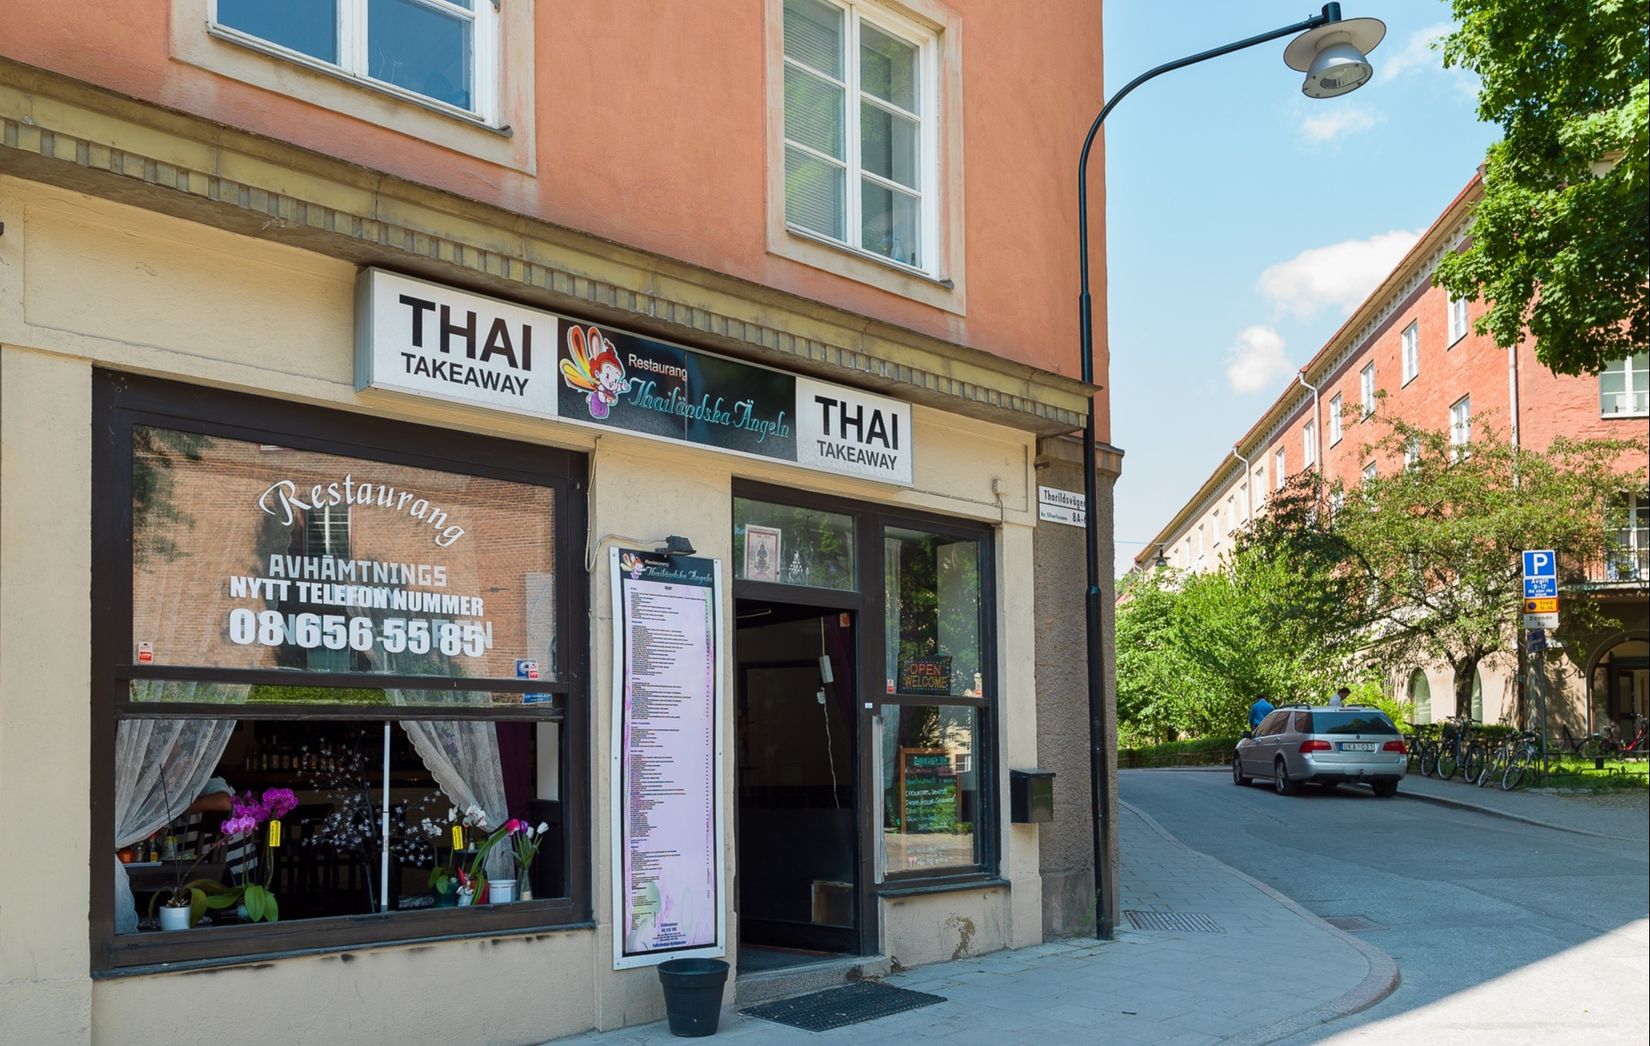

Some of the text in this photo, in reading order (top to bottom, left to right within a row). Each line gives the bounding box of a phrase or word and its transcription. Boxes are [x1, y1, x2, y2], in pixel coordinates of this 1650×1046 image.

[399, 294, 532, 372] THAI
[401, 352, 529, 397] TAKEAWAY
[628, 353, 688, 381] Restaurang
[628, 377, 790, 444] Thailändska Ängeln
[815, 395, 899, 450] THAI
[817, 440, 898, 470] TAKEAWAY
[258, 473, 465, 548] Restaurang
[269, 554, 448, 587] AVHÄMTNINGS
[1533, 553, 1548, 575] P
[230, 575, 484, 616] NYTT TELEFON NUMMER
[229, 608, 284, 646] 08
[904, 674, 949, 689] WELCOME
[910, 663, 942, 676] OPEN
